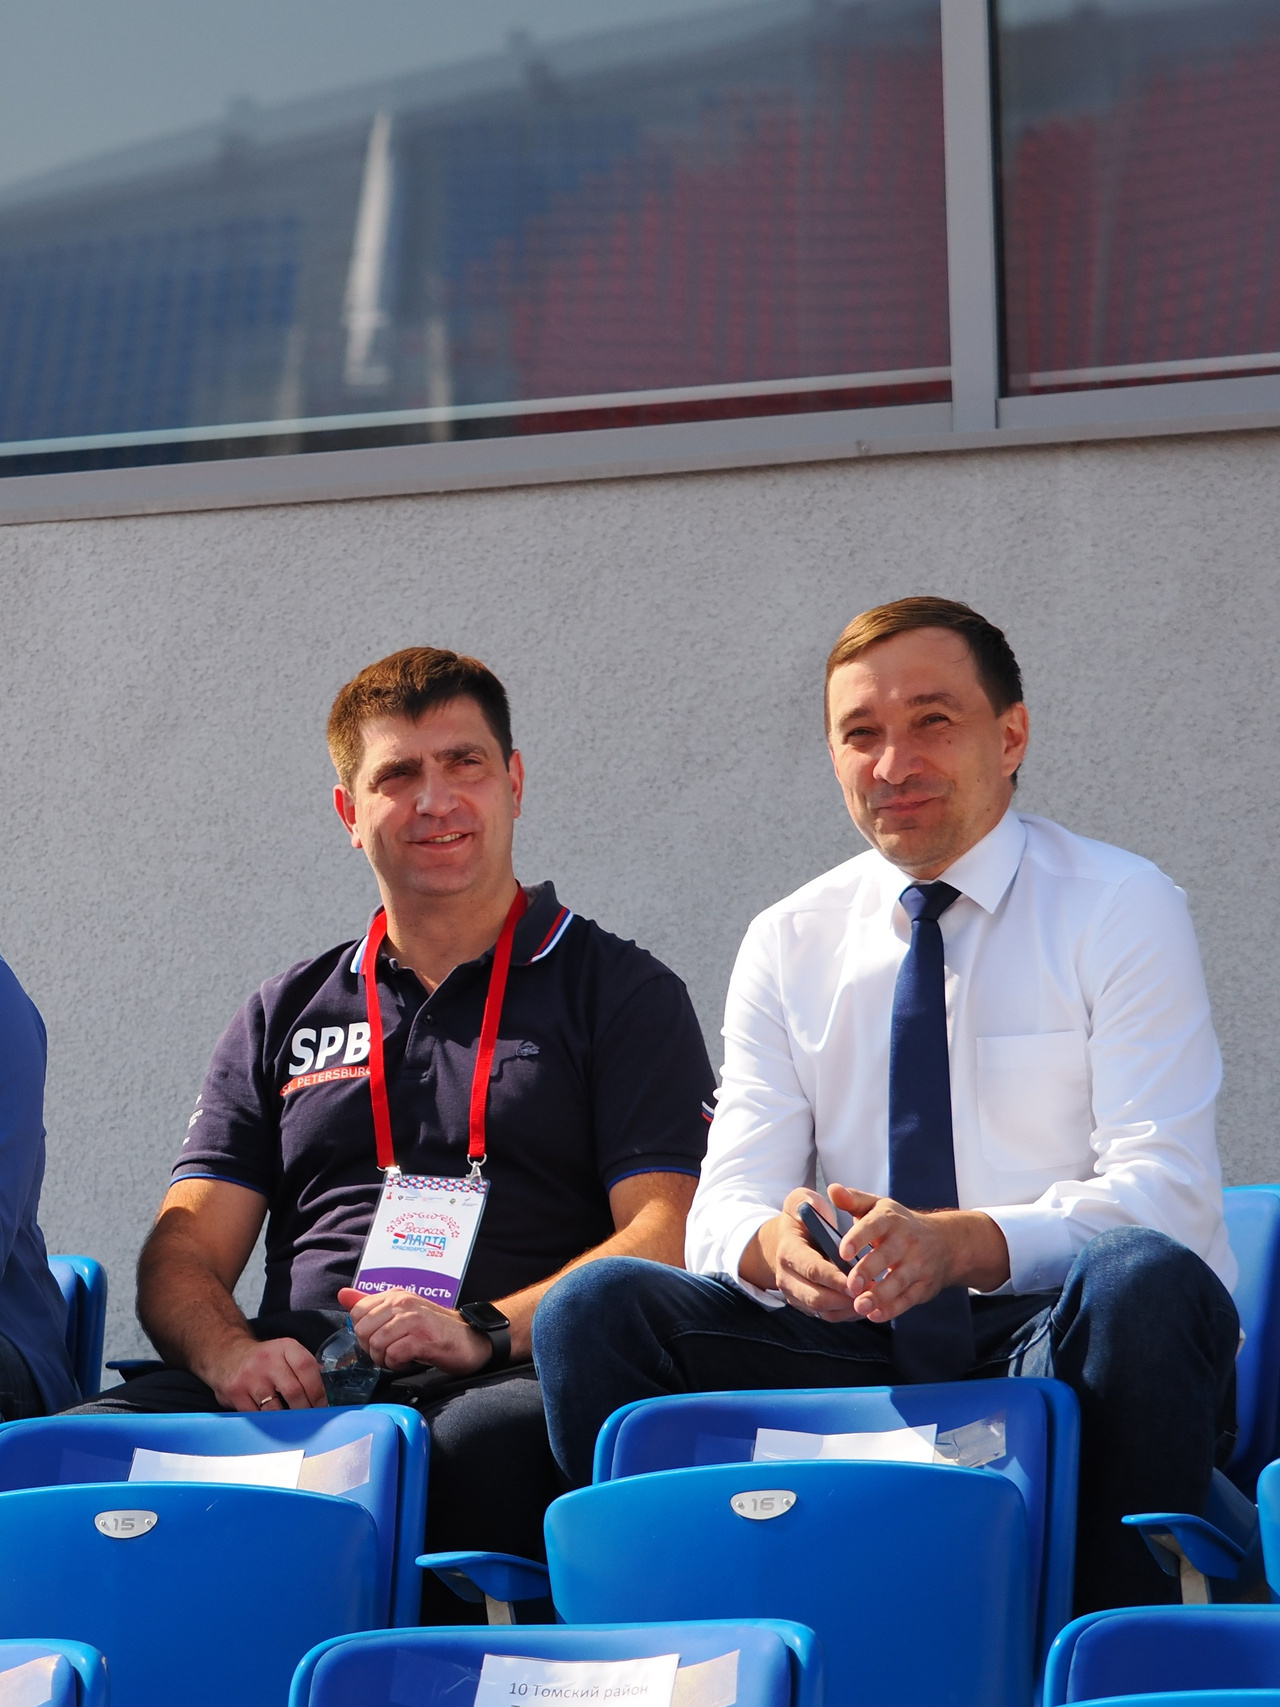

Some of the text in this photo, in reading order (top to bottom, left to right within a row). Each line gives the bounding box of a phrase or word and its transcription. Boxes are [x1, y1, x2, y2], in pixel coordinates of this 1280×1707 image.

[288, 1021, 371, 1076] SPB
[402, 1233, 446, 1251] ЛАПТА
[417, 1286, 451, 1298] ГОСТЬ
[752, 1497, 775, 1511] 16
[113, 1517, 135, 1531] 15
[508, 1682, 648, 1700] 10 Томский район
